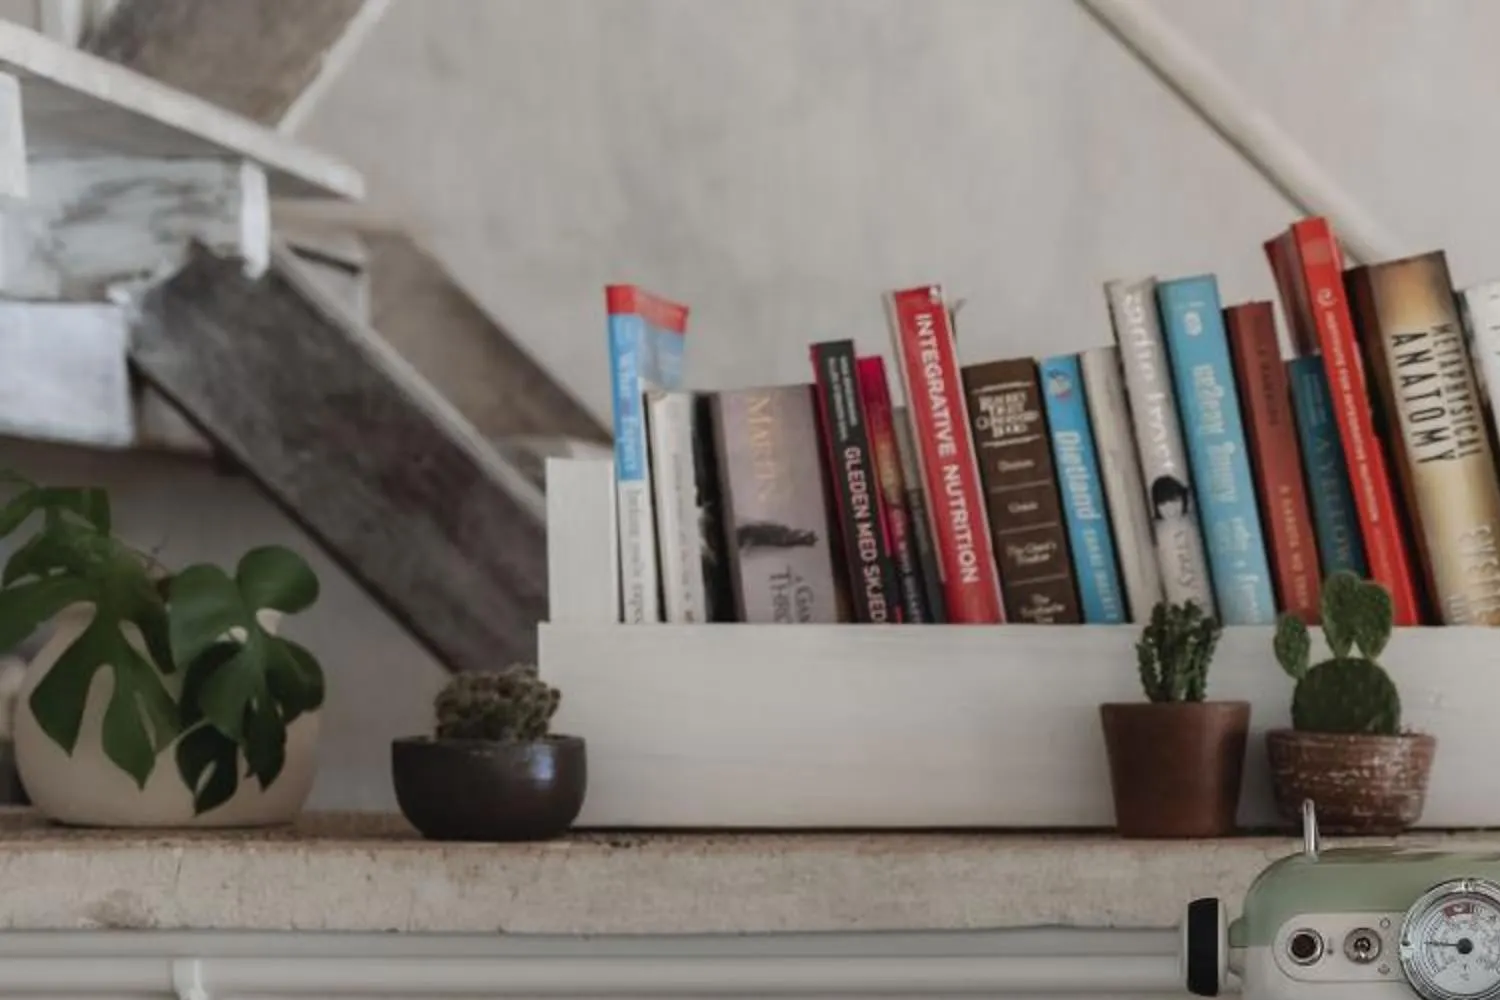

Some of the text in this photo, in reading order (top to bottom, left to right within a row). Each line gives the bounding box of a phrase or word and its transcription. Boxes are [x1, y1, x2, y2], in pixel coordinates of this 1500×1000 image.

[1391, 331, 1458, 464] ANATOMY
[1430, 322, 1484, 458] METAPHYSICAL
[845, 446, 871, 519] GLEDEN
[914, 313, 957, 455] INTEGRATIVE
[943, 464, 980, 583] NUTRITION
[1055, 431, 1101, 519] Dietland
[857, 521, 878, 561] MED
[864, 564, 887, 624] SKJED
